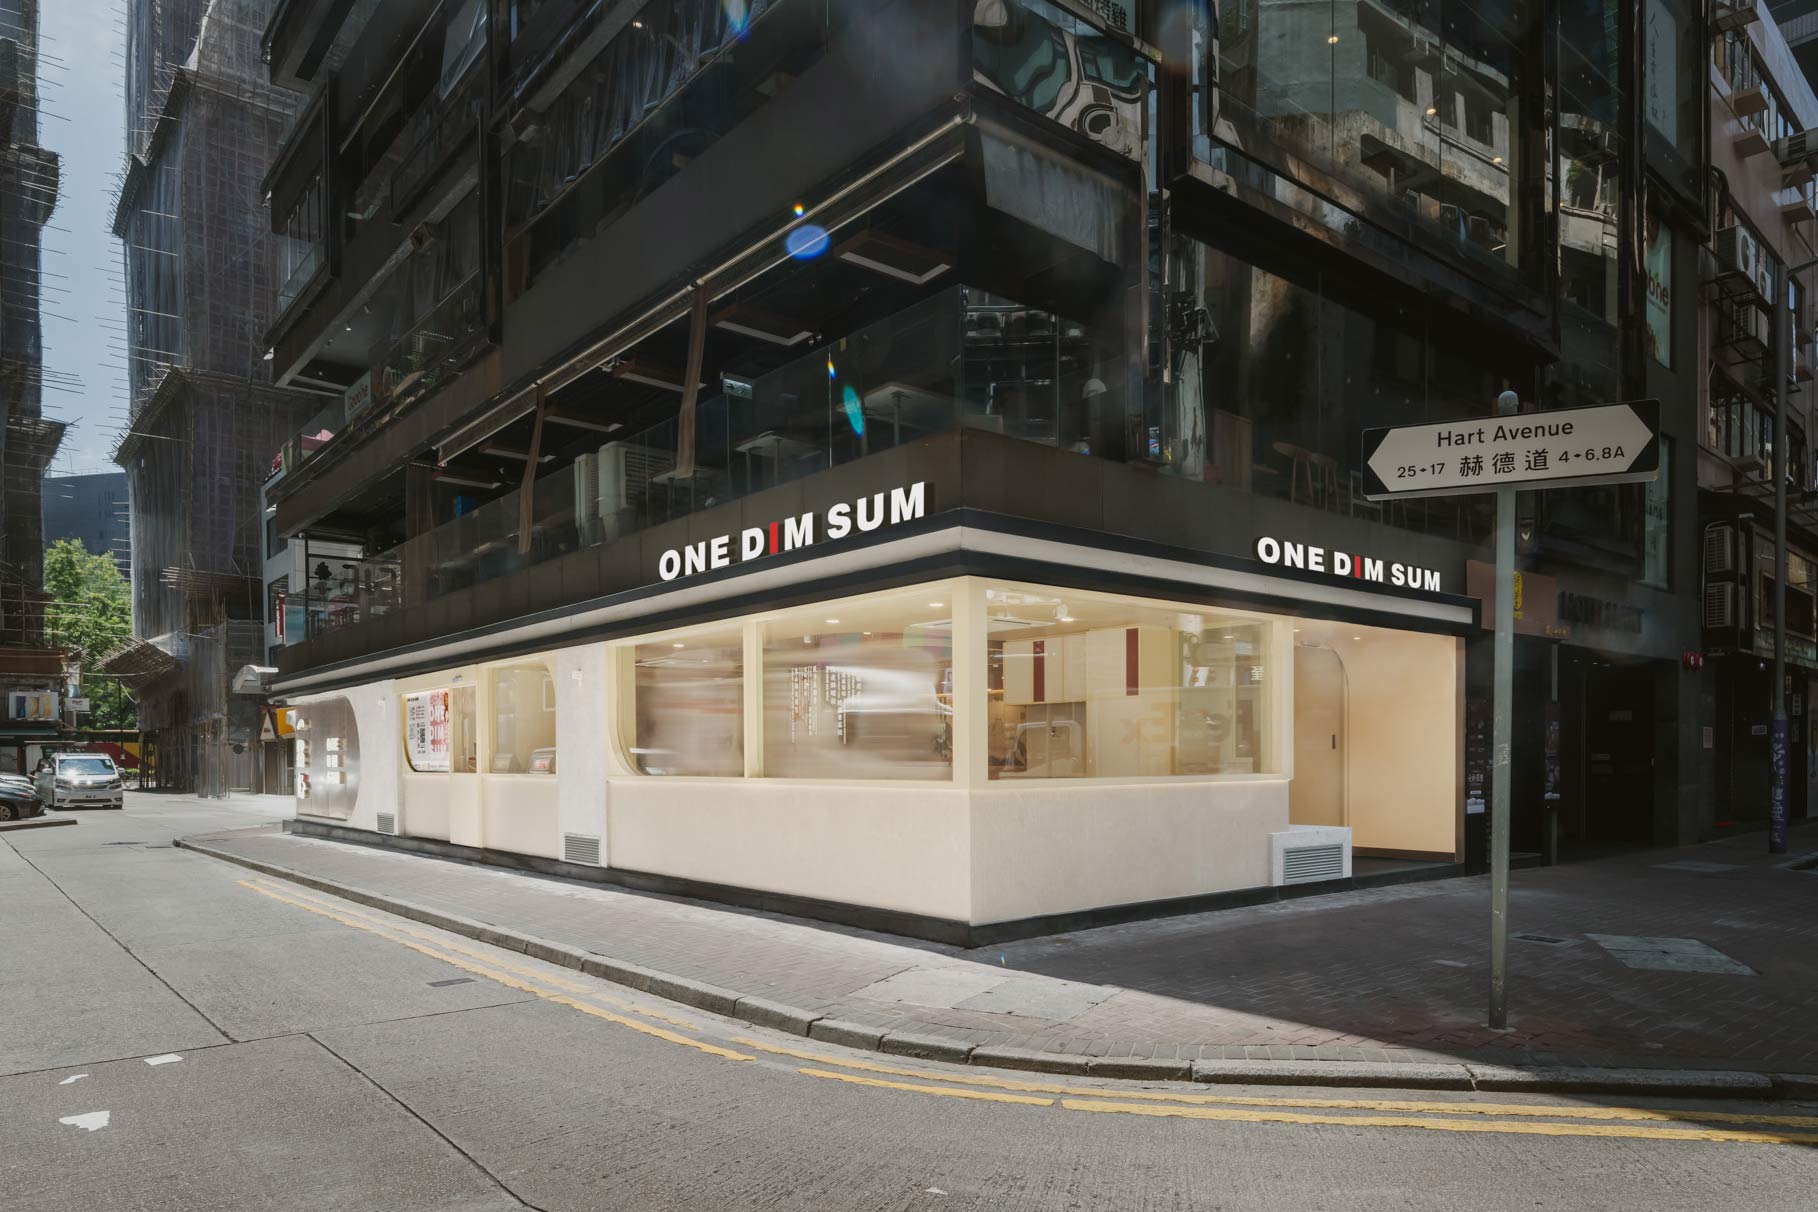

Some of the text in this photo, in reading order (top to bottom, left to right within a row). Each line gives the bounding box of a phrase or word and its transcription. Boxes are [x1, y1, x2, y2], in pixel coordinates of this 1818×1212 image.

[1437, 421, 1574, 448] Hart Avenue
[1459, 449, 1550, 477] 赫德道
[658, 481, 924, 581] ONE DIM SUM
[1257, 536, 1441, 592] ONE DIM SUM
